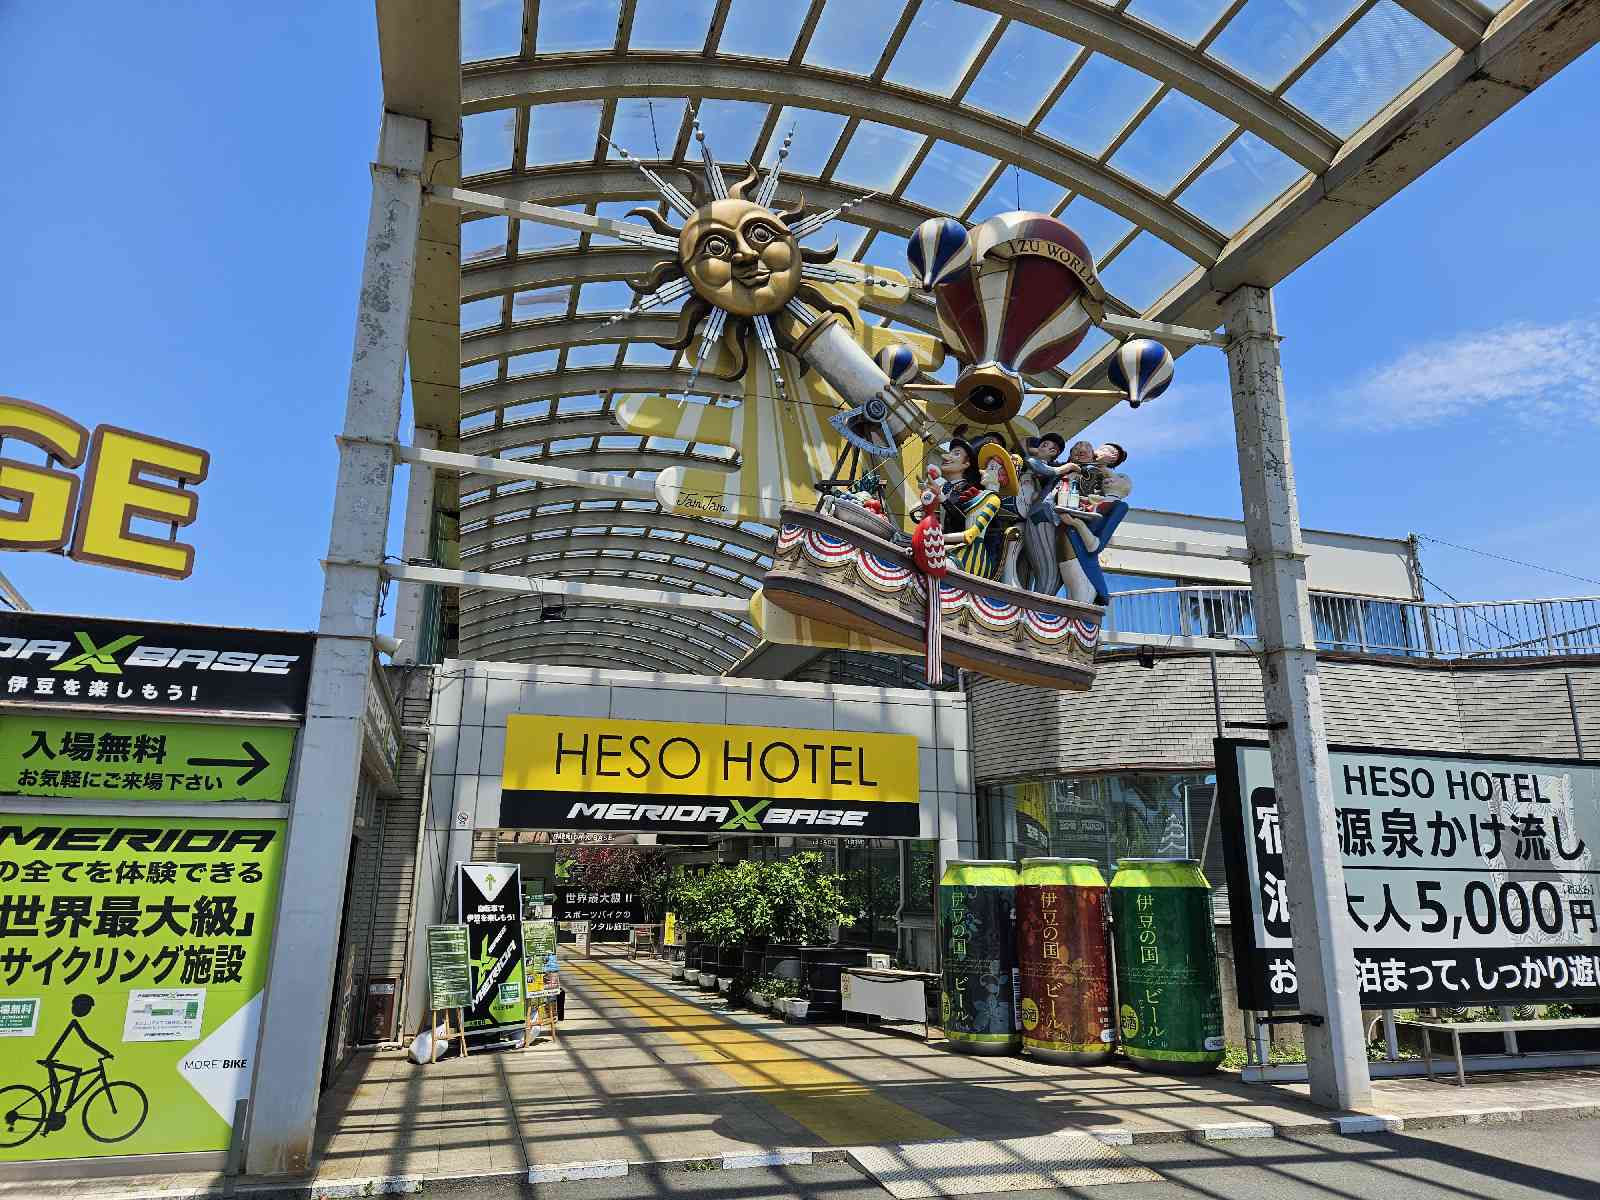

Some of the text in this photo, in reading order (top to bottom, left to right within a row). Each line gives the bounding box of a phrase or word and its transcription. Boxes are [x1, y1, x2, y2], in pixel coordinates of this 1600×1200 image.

[1047, 242, 1096, 286] WORLD
[0, 396, 210, 580] GE
[124, 646, 300, 675] BASE
[7, 675, 199, 701] 伊豆を楽しもう!
[22, 730, 167, 764] 入場無料
[555, 733, 878, 786] HESO HOTEL
[17, 768, 223, 791] お気軽にご来場下さい
[1343, 764, 1551, 804] HESO HOTEL
[567, 802, 729, 823] MERIDA
[762, 808, 869, 827] BASE
[1335, 806, 1586, 861] 源泉かけ流し
[0, 826, 276, 853] MERIDA
[0, 860, 263, 884] の全てを体験できる
[0, 895, 255, 938] 世界最大級」
[1041, 891, 1059, 959] 伊豆の国
[0, 944, 247, 985] サイクリング施設
[1136, 894, 1167, 1037] 伊豆の国 ビール
[1046, 982, 1064, 1029] ビール
[184, 1059, 248, 1070] MORE BIKE
